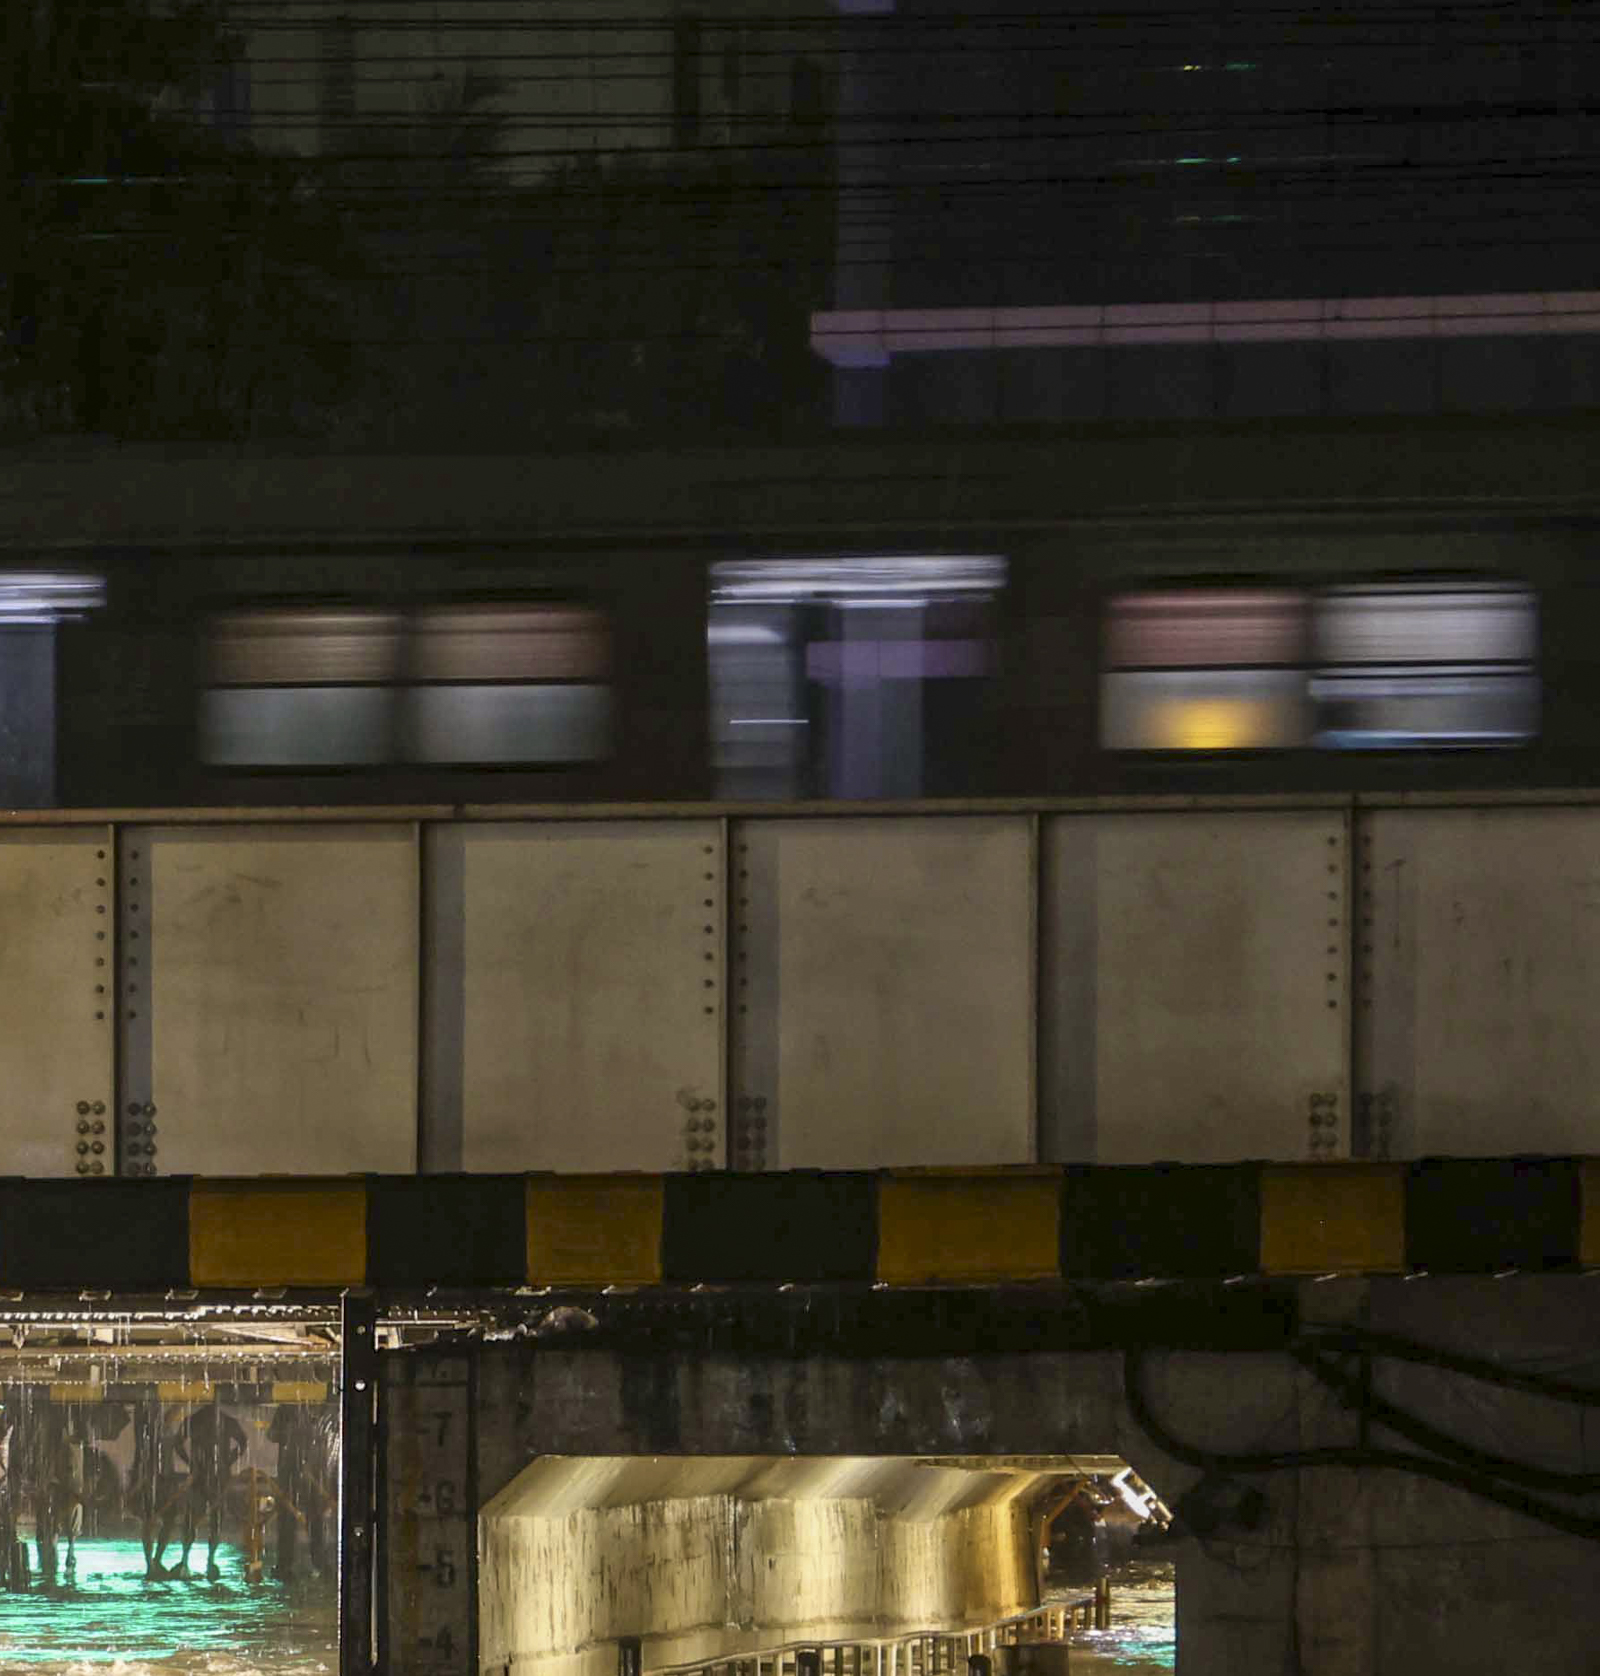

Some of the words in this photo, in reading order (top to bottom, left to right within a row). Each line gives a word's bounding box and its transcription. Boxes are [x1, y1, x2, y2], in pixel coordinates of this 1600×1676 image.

[434, 1412, 453, 1448] 7
[435, 1549, 455, 1590] 5
[434, 1622, 457, 1661] 4
